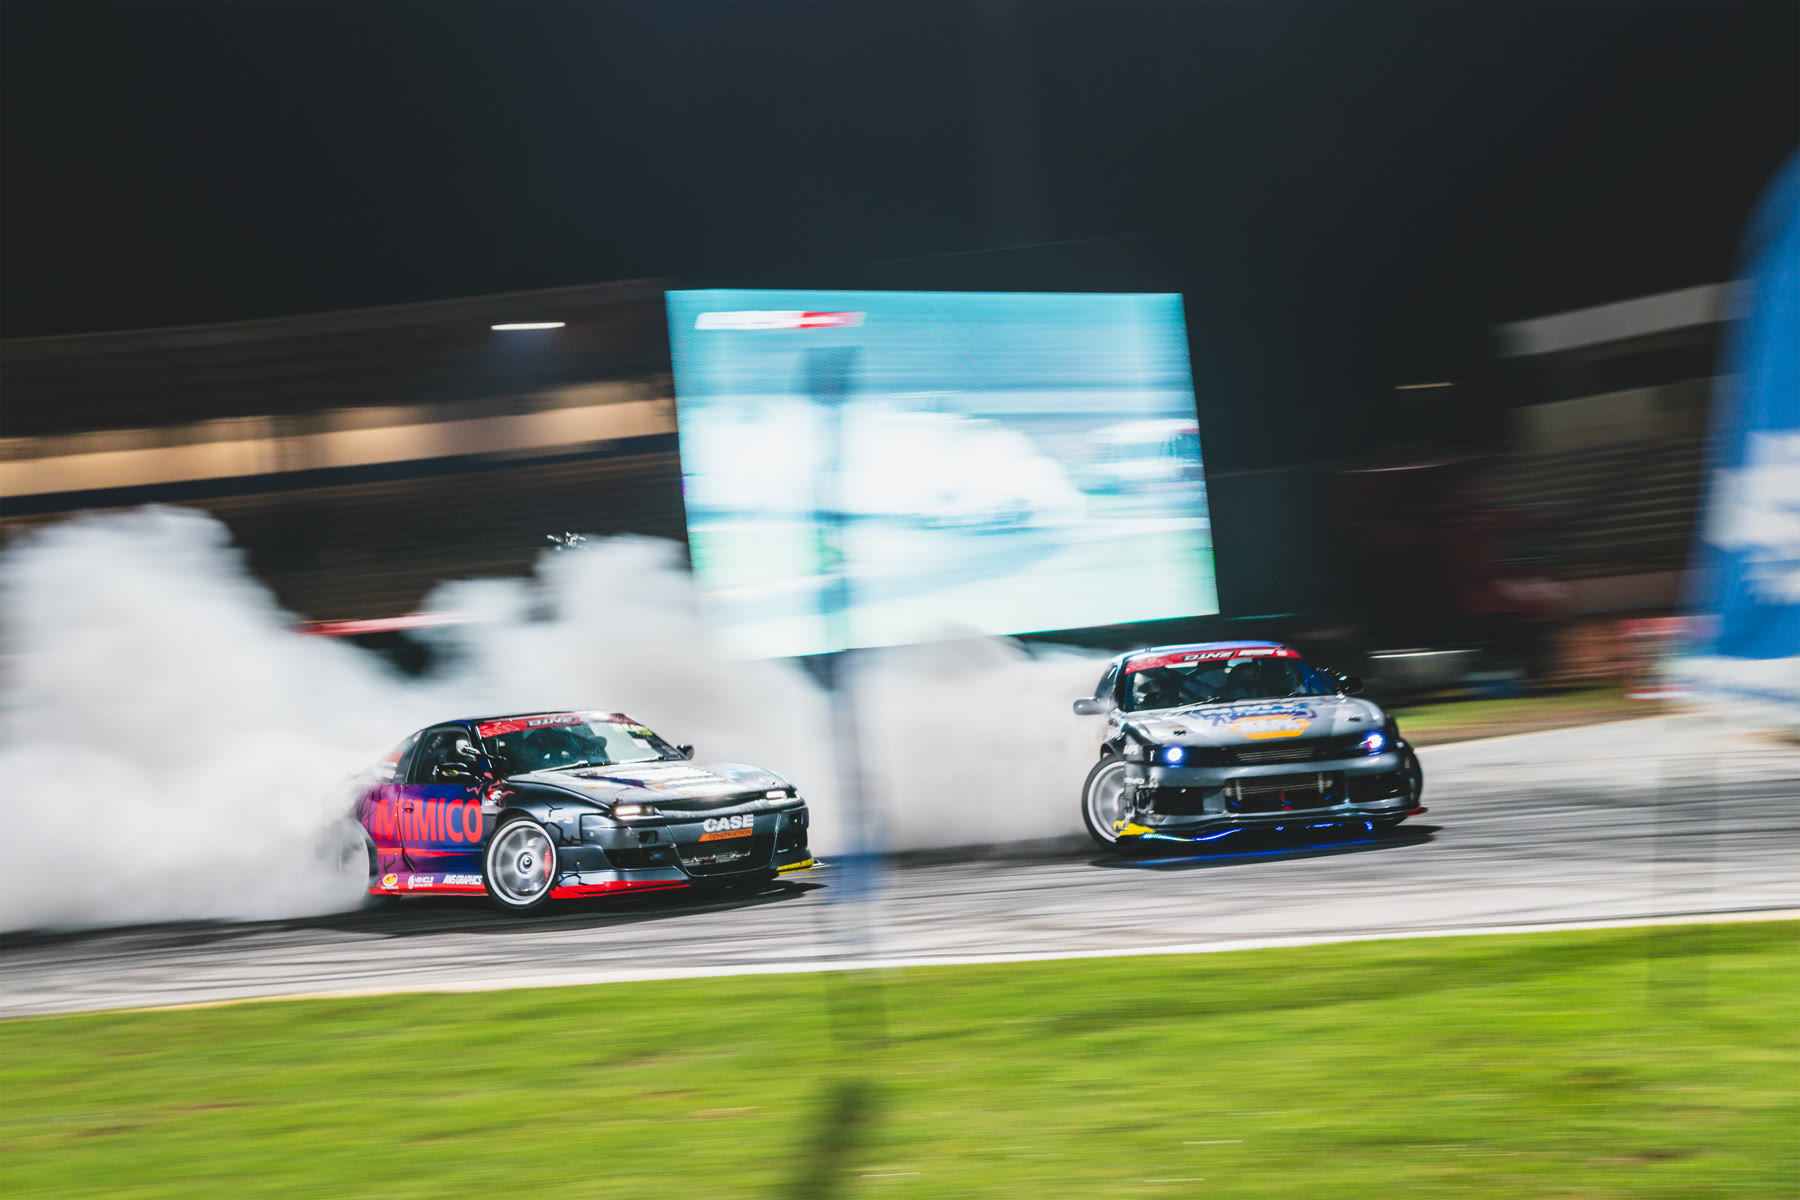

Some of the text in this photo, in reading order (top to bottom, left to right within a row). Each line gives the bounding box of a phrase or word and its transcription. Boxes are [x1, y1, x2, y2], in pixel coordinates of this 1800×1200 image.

[375, 798, 483, 843] MIMICO
[703, 814, 754, 832] CASE
[709, 829, 752, 839] CONSTRUCTION
